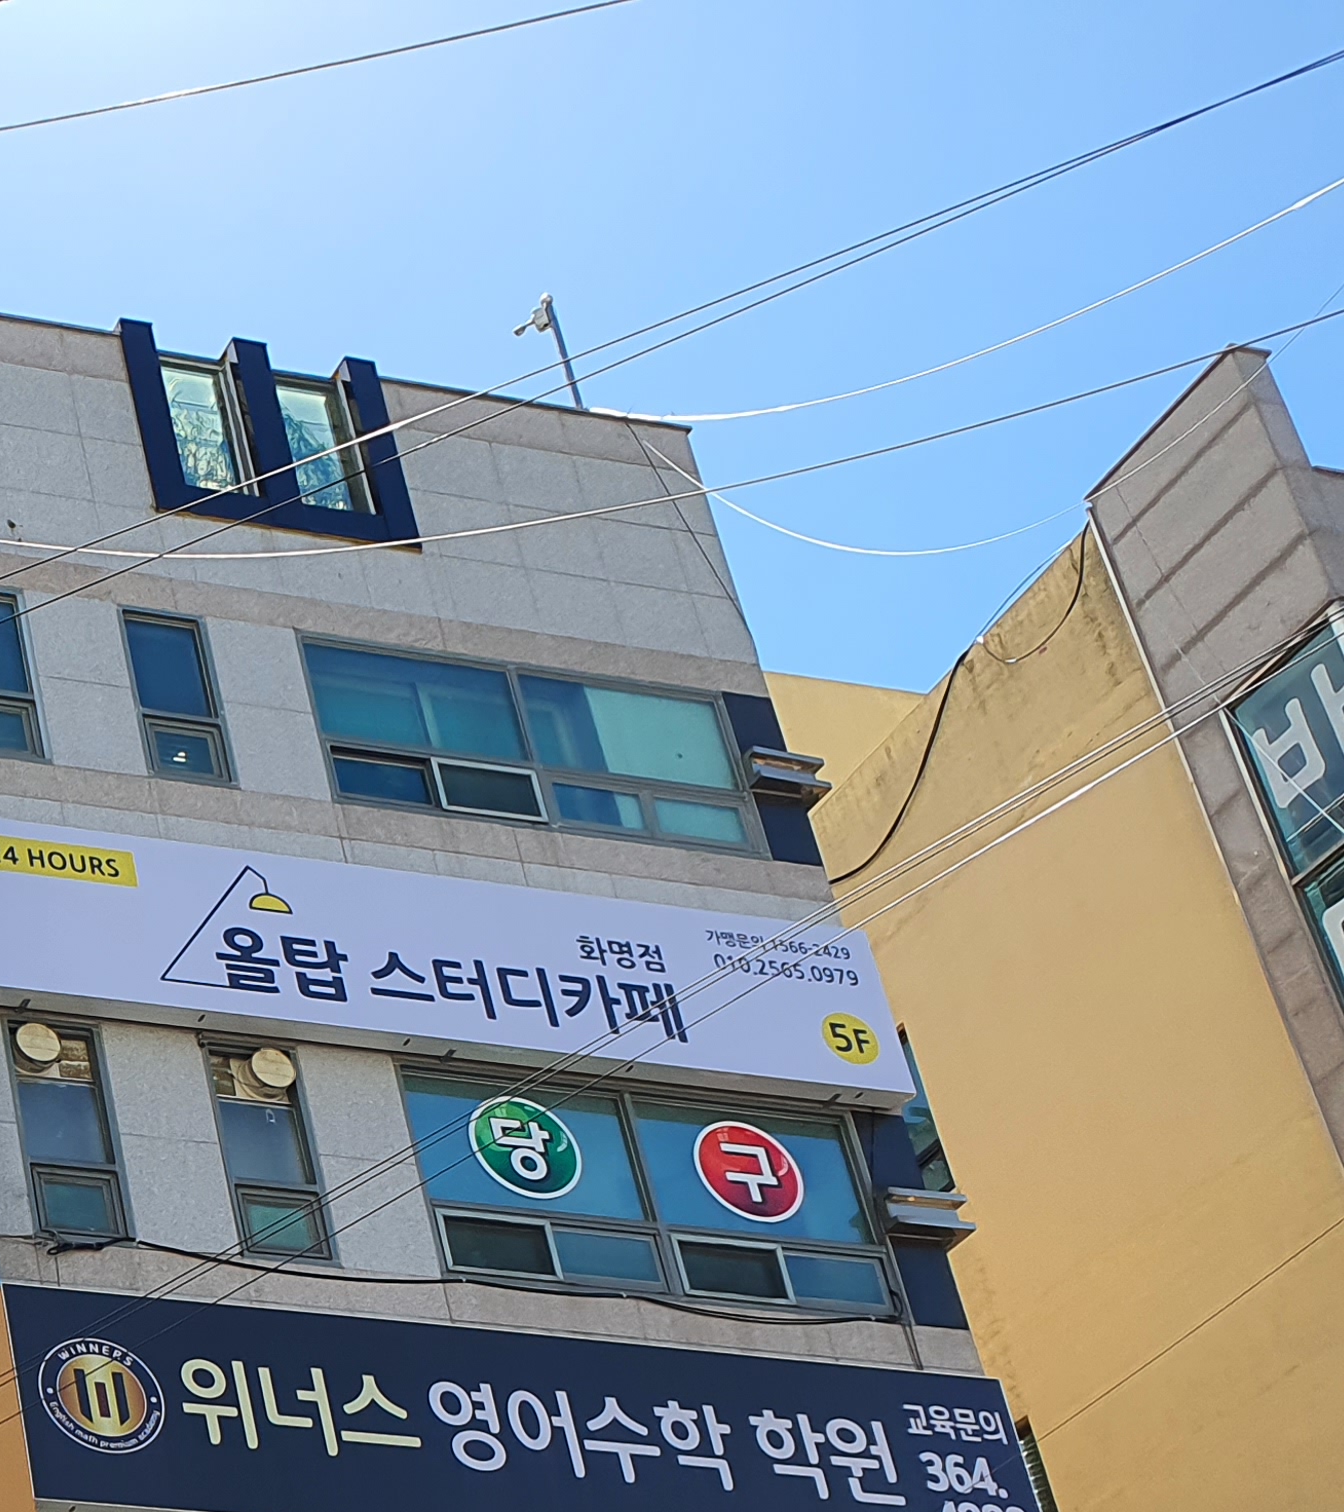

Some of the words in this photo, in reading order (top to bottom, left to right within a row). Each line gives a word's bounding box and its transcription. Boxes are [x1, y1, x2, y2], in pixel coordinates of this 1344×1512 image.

[27, 849, 120, 878] HOURS
[576, 935, 666, 974] 화명점
[215, 926, 349, 1002] 올탑
[369, 951, 689, 1043] 스터디카페
[828, 1021, 871, 1055] 5F
[180, 1358, 422, 1458] 위너스
[428, 1380, 734, 1491] 영어수학
[748, 1408, 907, 1507] 학원
[901, 1402, 1009, 1446] 교육문의
